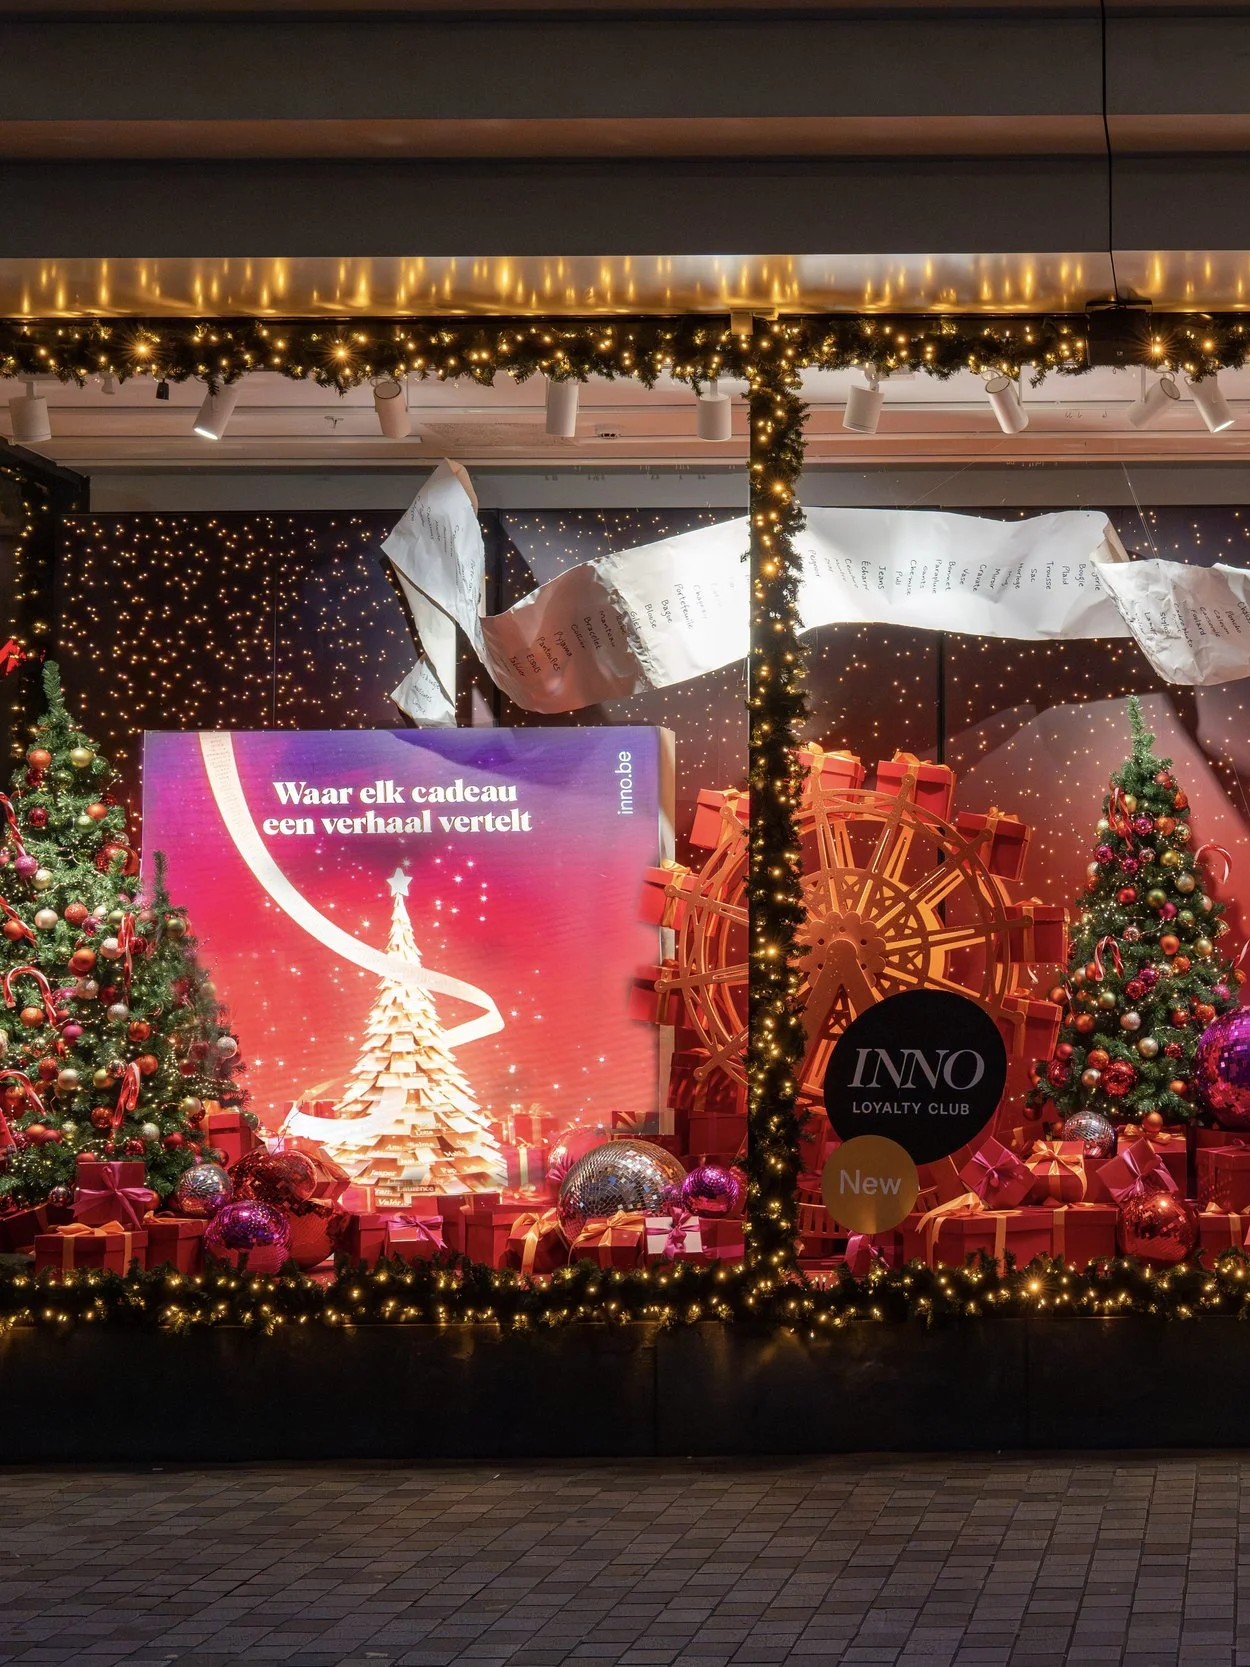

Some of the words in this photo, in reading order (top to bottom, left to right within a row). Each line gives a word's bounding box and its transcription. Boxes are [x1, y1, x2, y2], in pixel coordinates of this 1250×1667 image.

[877, 565, 887, 590] Jeans
[895, 570, 903, 586] Pull
[905, 559, 918, 596] Chemise
[919, 565, 929, 589] Gants
[931, 559, 943, 594] Parapluie
[945, 561, 957, 592] Bonnet
[959, 568, 971, 585] Vase
[972, 563, 988, 592] Cravate
[1012, 562, 1025, 590] Horloge
[1030, 568, 1038, 583] Sac
[1045, 561, 1055, 590] Trousse
[1062, 565, 1071, 586] Plaid
[1074, 563, 1087, 587] Bougie
[644, 603, 657, 629] Blouse
[660, 599, 673, 624] Bague
[674, 583, 694, 630] Portefeuille
[583, 616, 601, 649] Bracelet
[630, 610, 642, 631] Gilet
[1190, 609, 1207, 637] Foulard
[1225, 610, 1242, 634] Poncho
[537, 636, 560, 672] Pantoufles
[554, 631, 573, 657] Pyjama
[272, 780, 353, 805] Waar
[359, 779, 406, 804] elk
[411, 778, 518, 804] cadeau
[615, 750, 633, 816] inno.be
[262, 817, 316, 836] een
[323, 809, 433, 836] verhaal
[438, 808, 533, 834] vertelt
[847, 1048, 985, 1091] INNO
[852, 1101, 922, 1115] LOYALTY
[928, 1102, 970, 1115] CLUB
[839, 1169, 901, 1195] New
